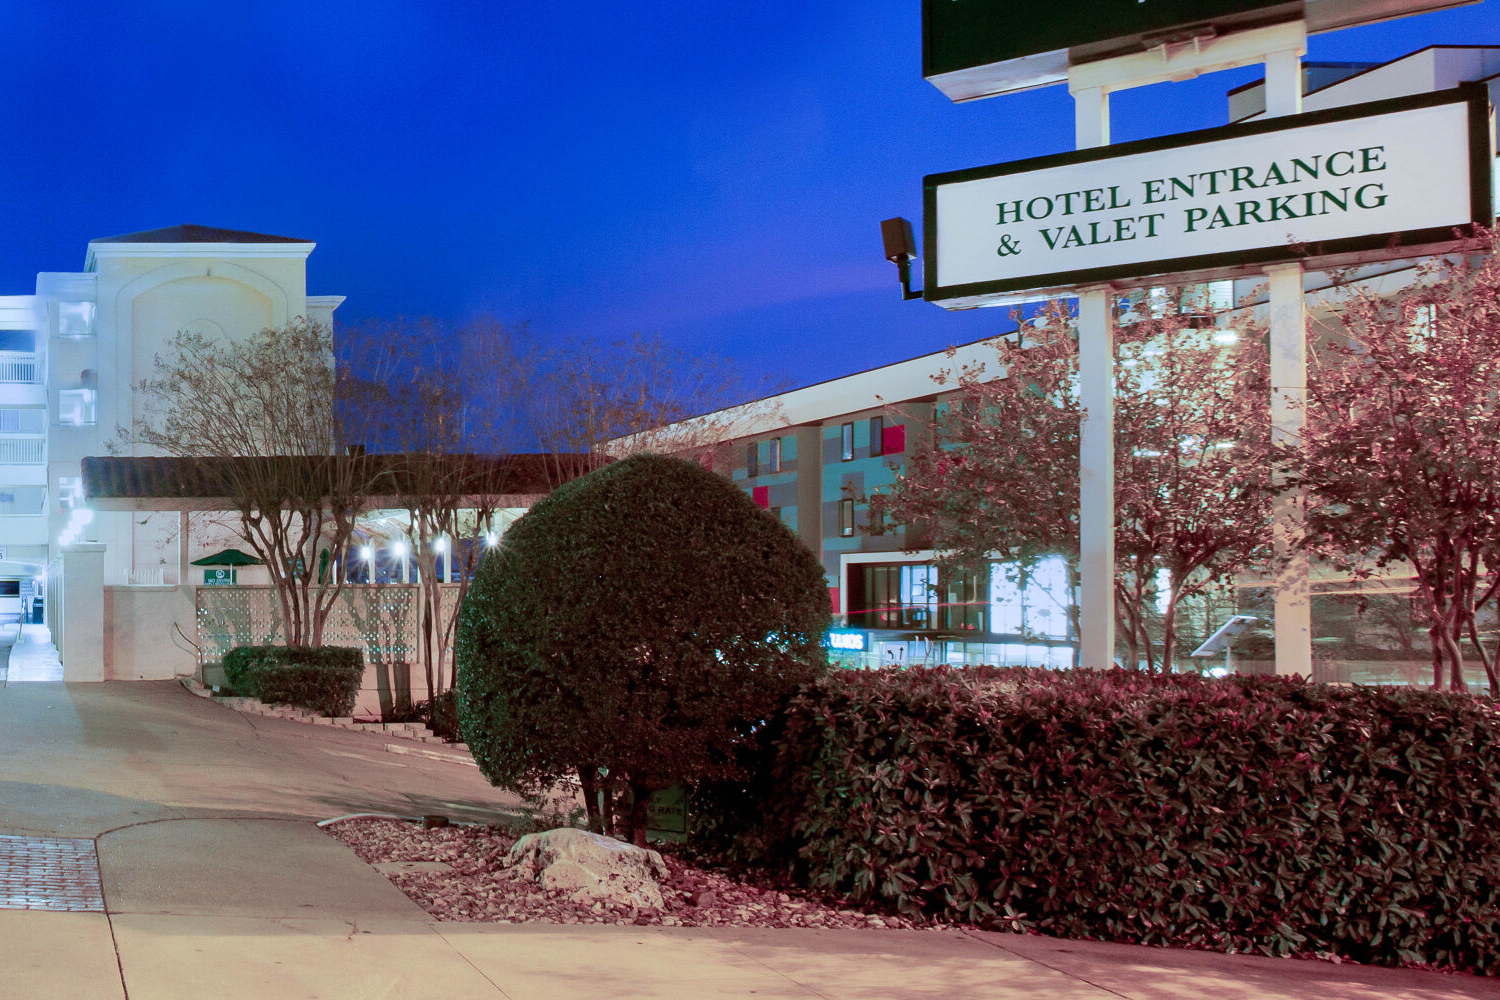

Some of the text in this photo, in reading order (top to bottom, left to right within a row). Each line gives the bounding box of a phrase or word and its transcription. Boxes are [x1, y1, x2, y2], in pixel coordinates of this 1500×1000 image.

[995, 145, 1387, 226] HOTEL ENTRANCE
[996, 182, 1389, 258] & VALET PARKING
